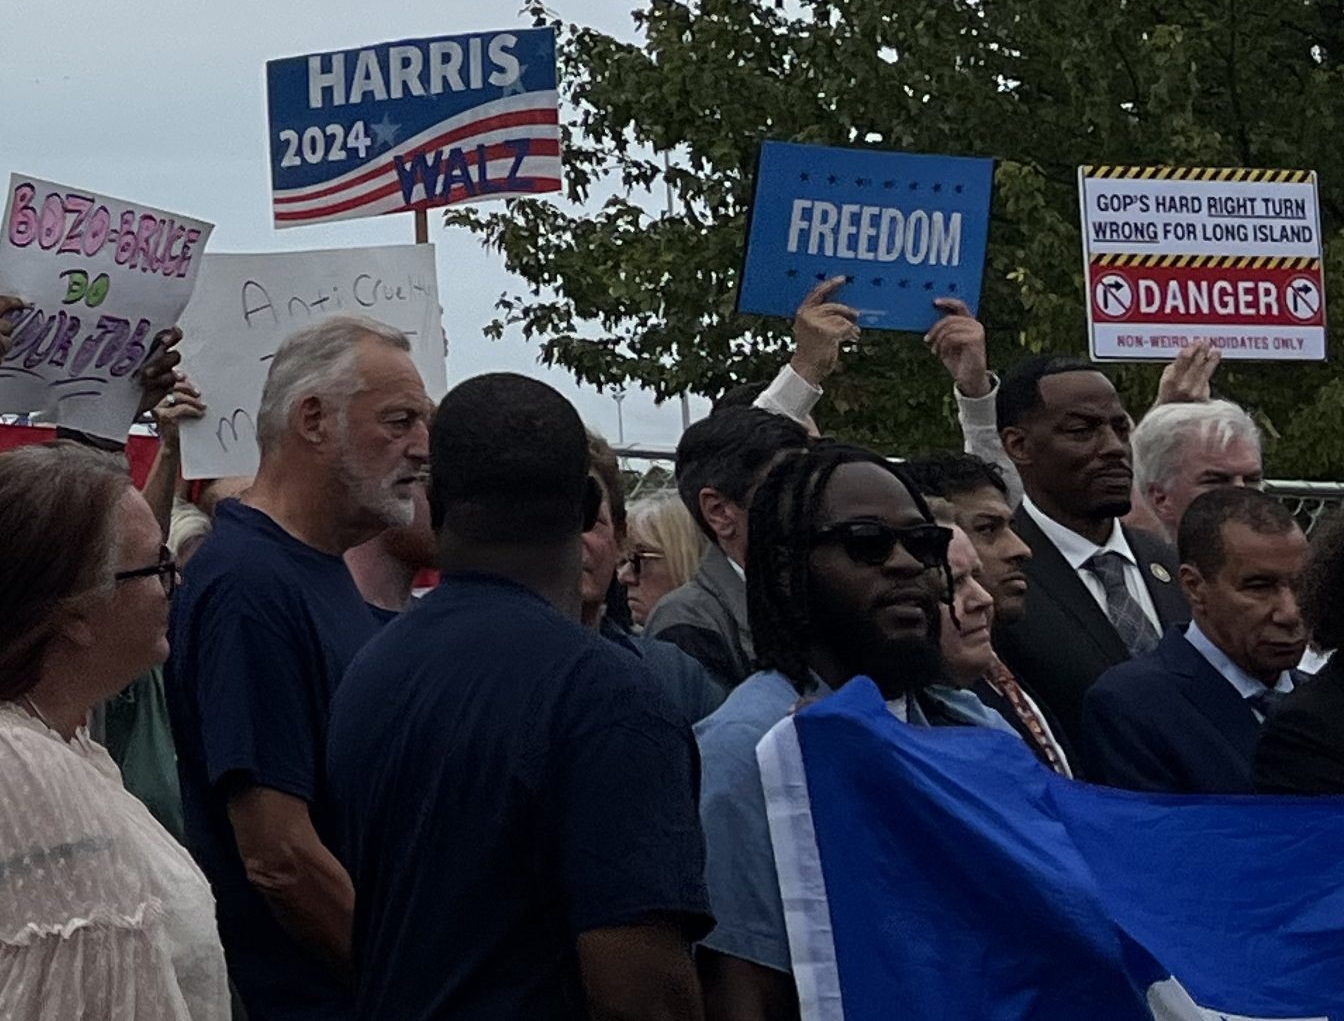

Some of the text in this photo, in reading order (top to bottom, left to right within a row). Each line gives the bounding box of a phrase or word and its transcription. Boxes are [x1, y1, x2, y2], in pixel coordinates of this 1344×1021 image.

[308, 33, 521, 109] HARRIS
[279, 121, 372, 168] 2024
[393, 137, 535, 206] WALZ
[1096, 193, 1306, 217] GOP'S HARD RIGHT TURN
[787, 198, 962, 267] FREEDOM
[1092, 221, 1312, 243] WRONG FOR LONG ISLAND
[1138, 279, 1279, 316] DANGER
[1117, 335, 1189, 348] NON-WEIRD
[1273, 337, 1305, 351] ONLY
